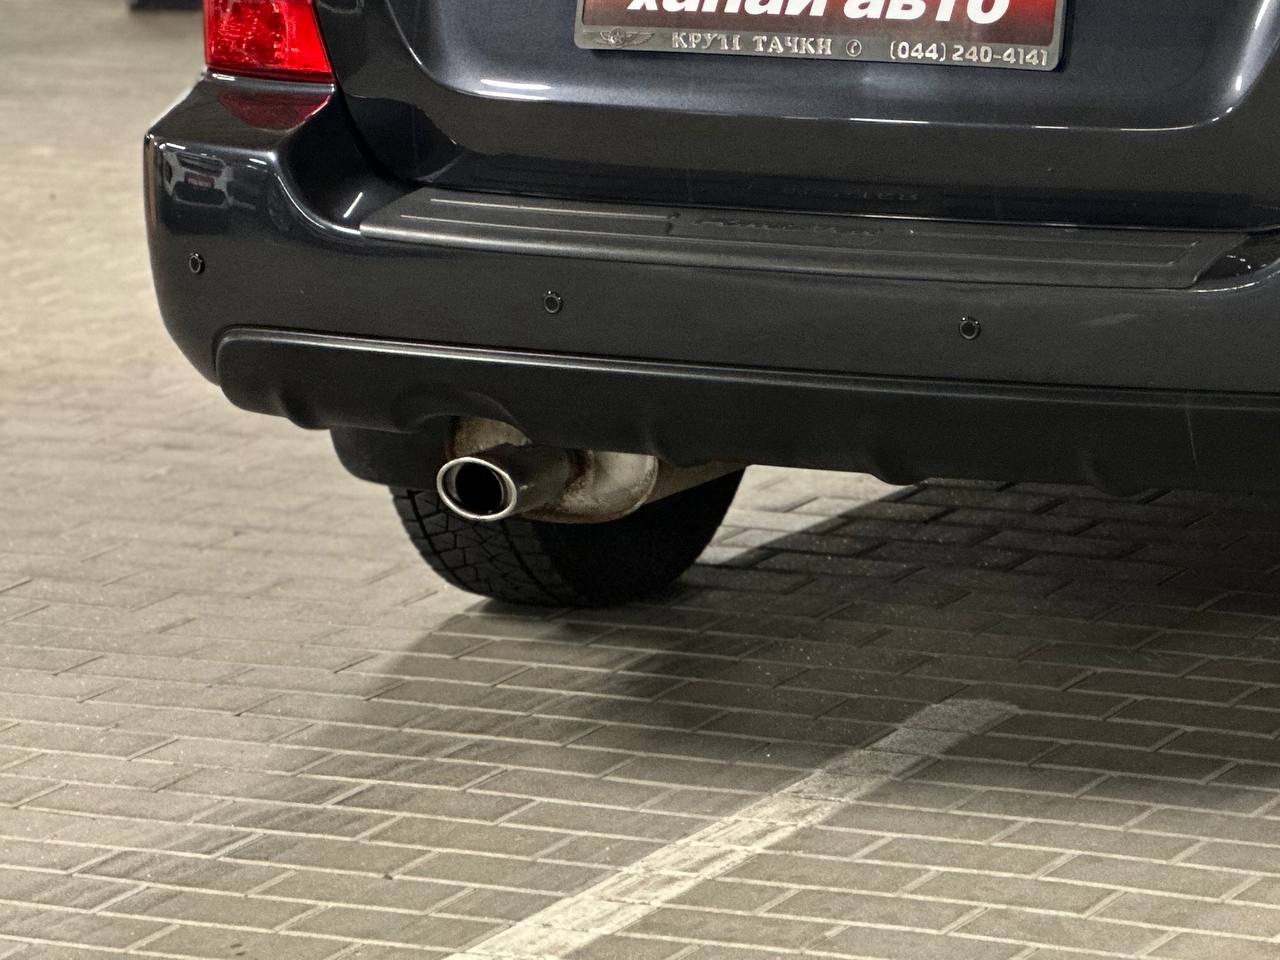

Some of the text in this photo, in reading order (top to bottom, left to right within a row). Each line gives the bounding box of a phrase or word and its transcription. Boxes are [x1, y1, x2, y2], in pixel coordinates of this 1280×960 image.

[752, 34, 832, 56] ТАЧКИ
[890, 41, 946, 62] (044)
[952, 44, 1048, 66] 240-4141
